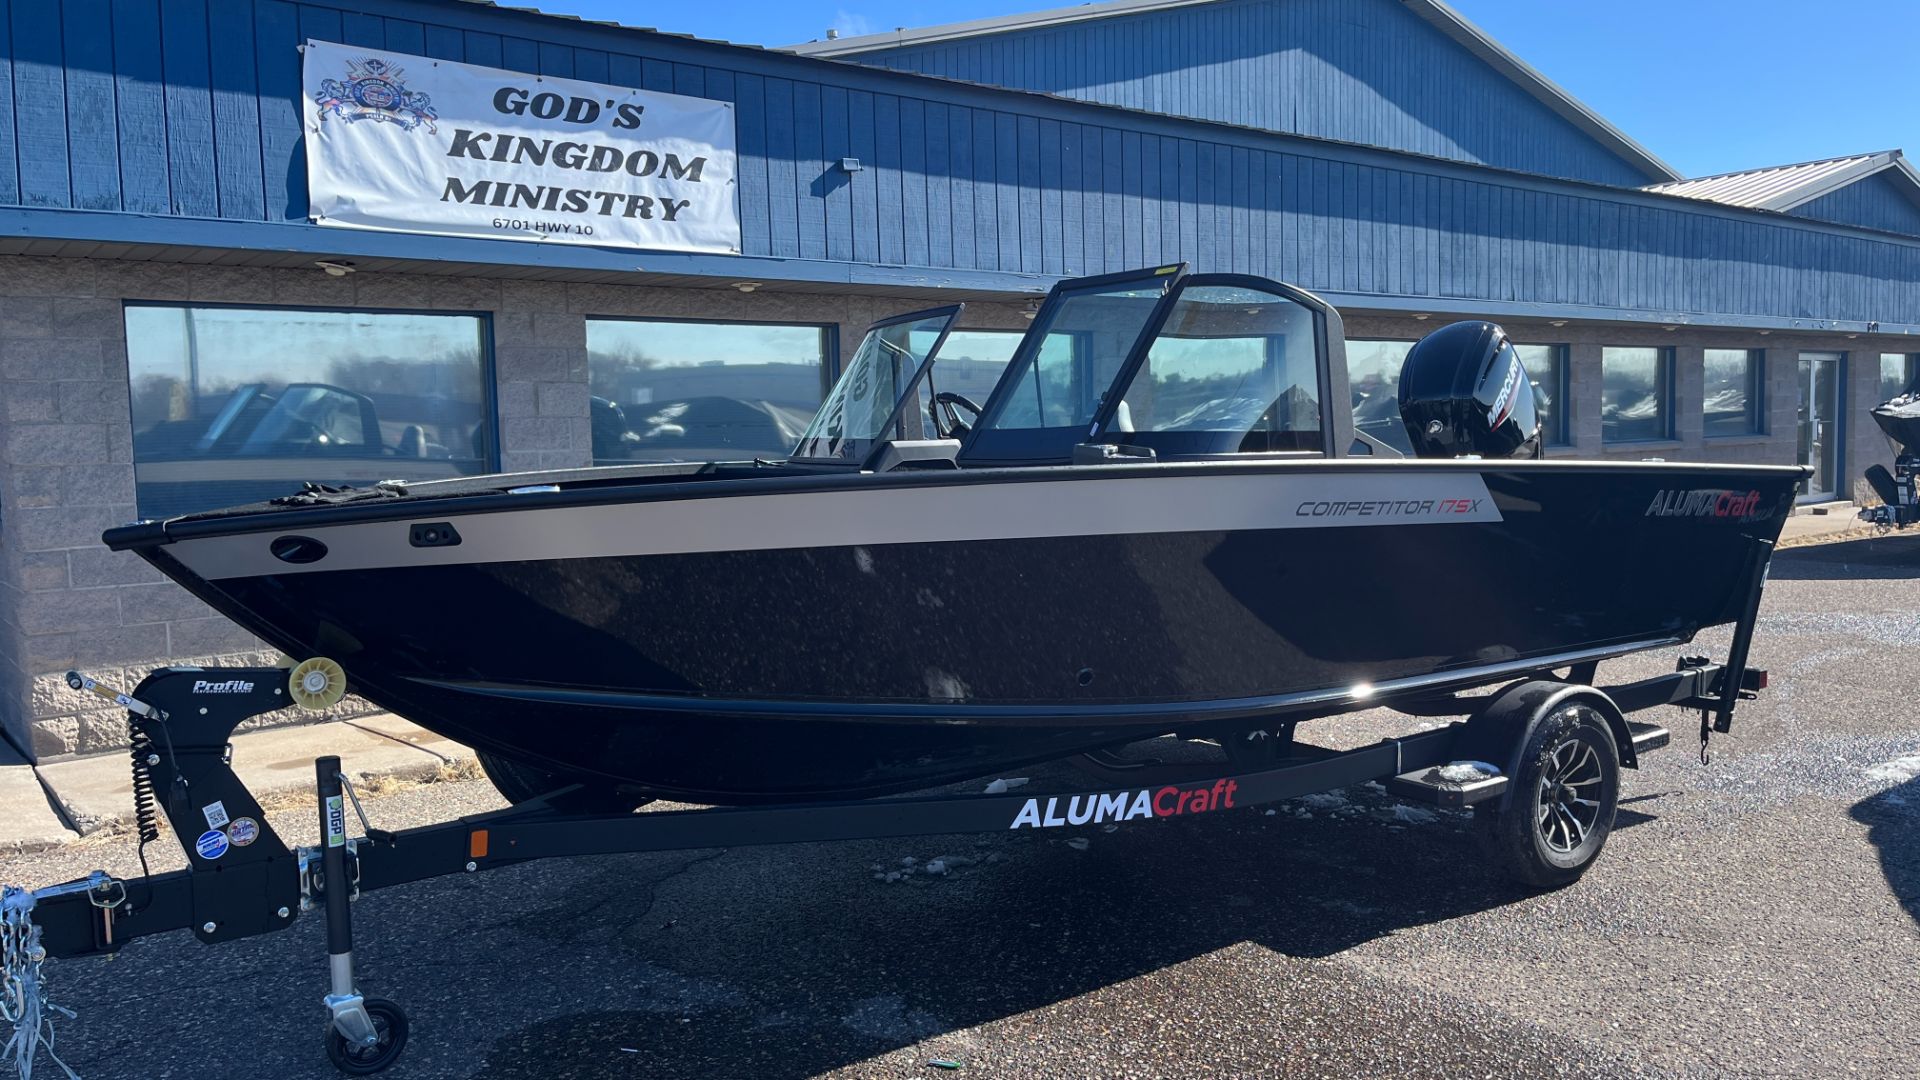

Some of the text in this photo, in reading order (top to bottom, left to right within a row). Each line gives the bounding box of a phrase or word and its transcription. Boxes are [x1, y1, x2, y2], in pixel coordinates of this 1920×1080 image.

[493, 87, 645, 130] GOD'S
[447, 129, 707, 182] KINGDOM
[440, 177, 691, 222] MINISTRY
[492, 218, 594, 236] 6701 HWY 10
[1296, 499, 1483, 516] COMPETITOR 175X
[1645, 489, 1761, 517] ALUMACraft
[193, 681, 254, 690] Profile
[1009, 778, 1238, 829] ALUMACraft
[331, 810, 342, 835] DGP
